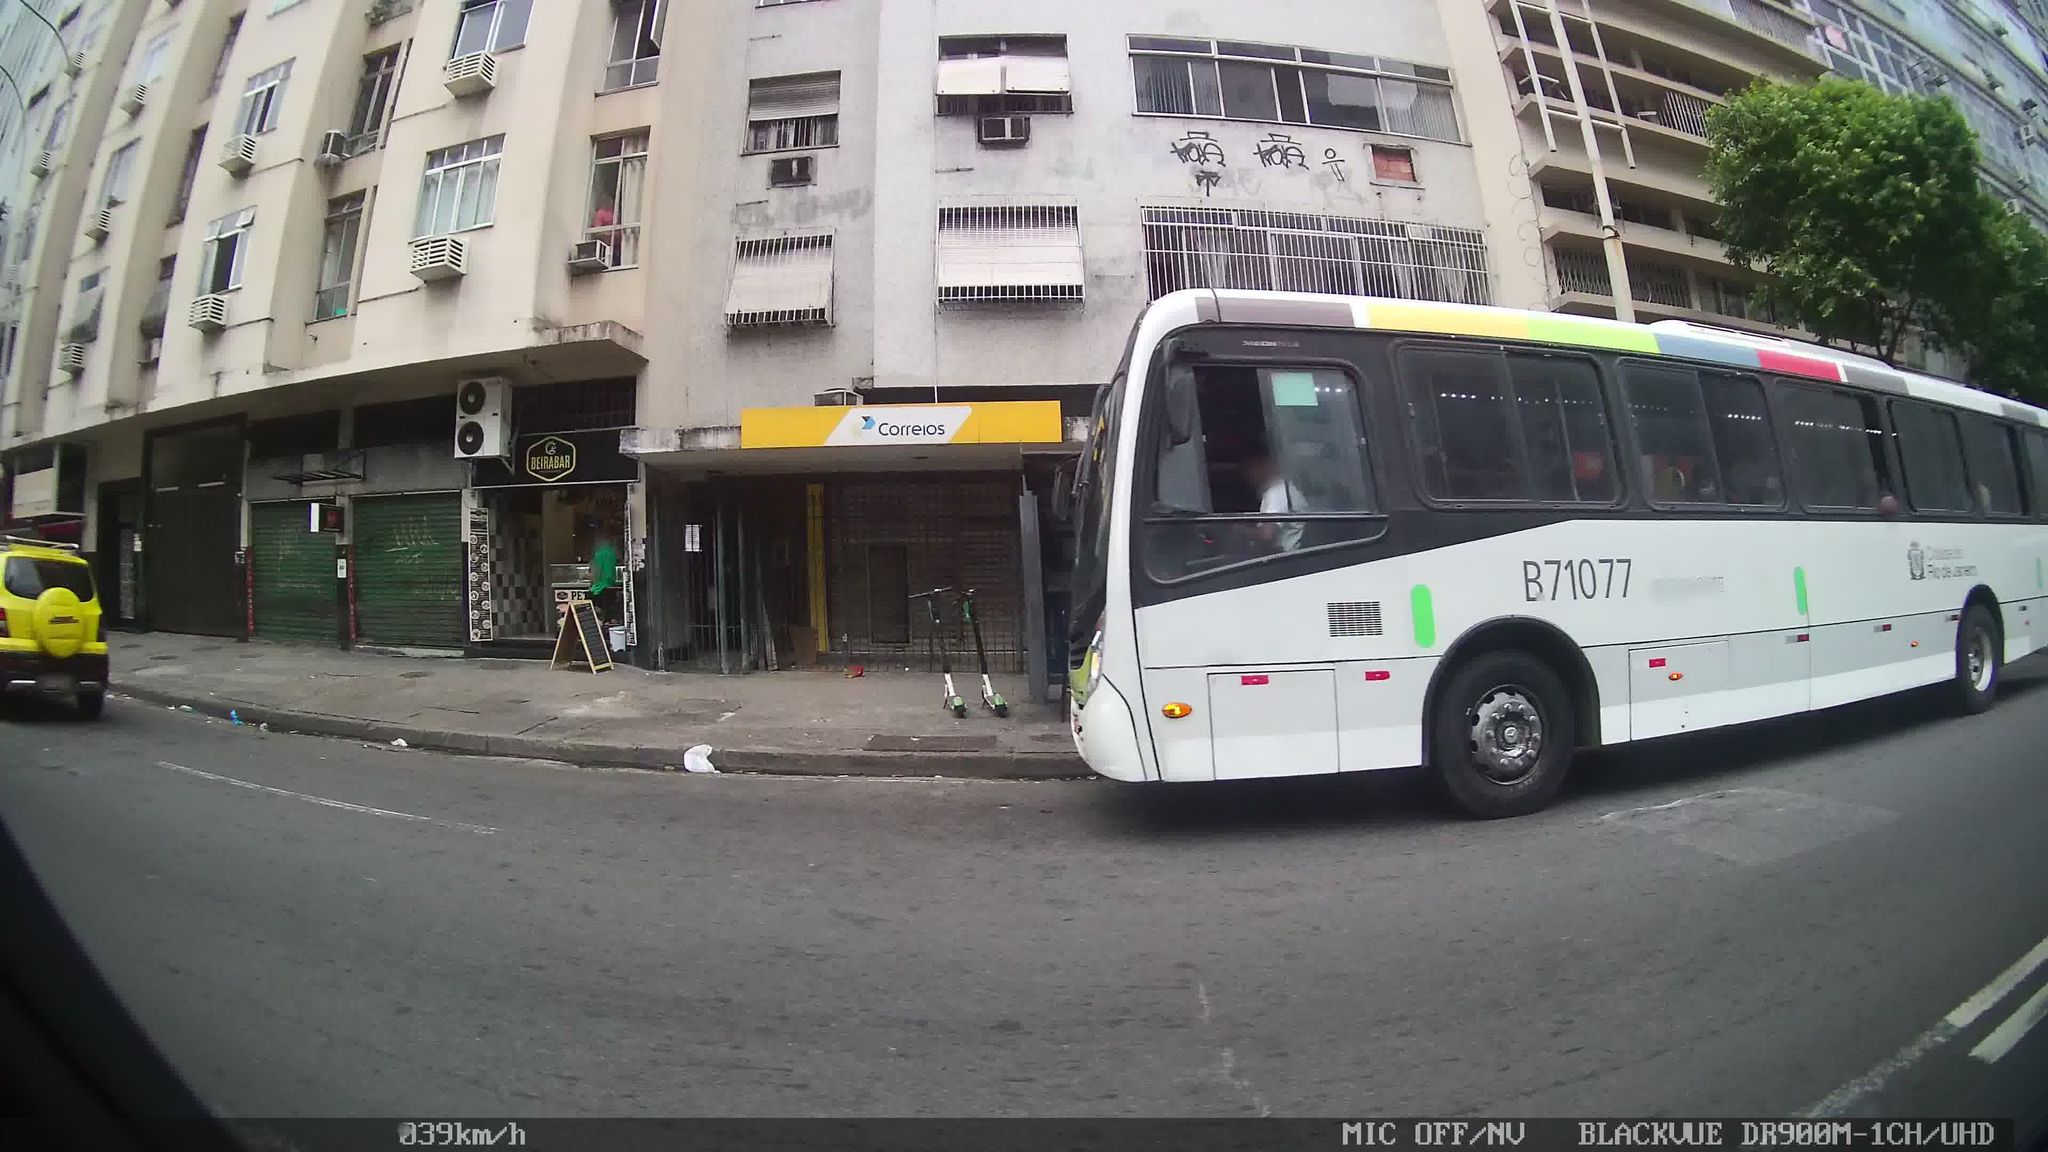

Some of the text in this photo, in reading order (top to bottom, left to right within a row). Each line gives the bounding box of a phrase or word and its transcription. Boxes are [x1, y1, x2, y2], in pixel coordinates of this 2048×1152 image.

[878, 422, 946, 436] Correios
[531, 455, 571, 470] BEIRABAR
[1523, 558, 1632, 602] B71077
